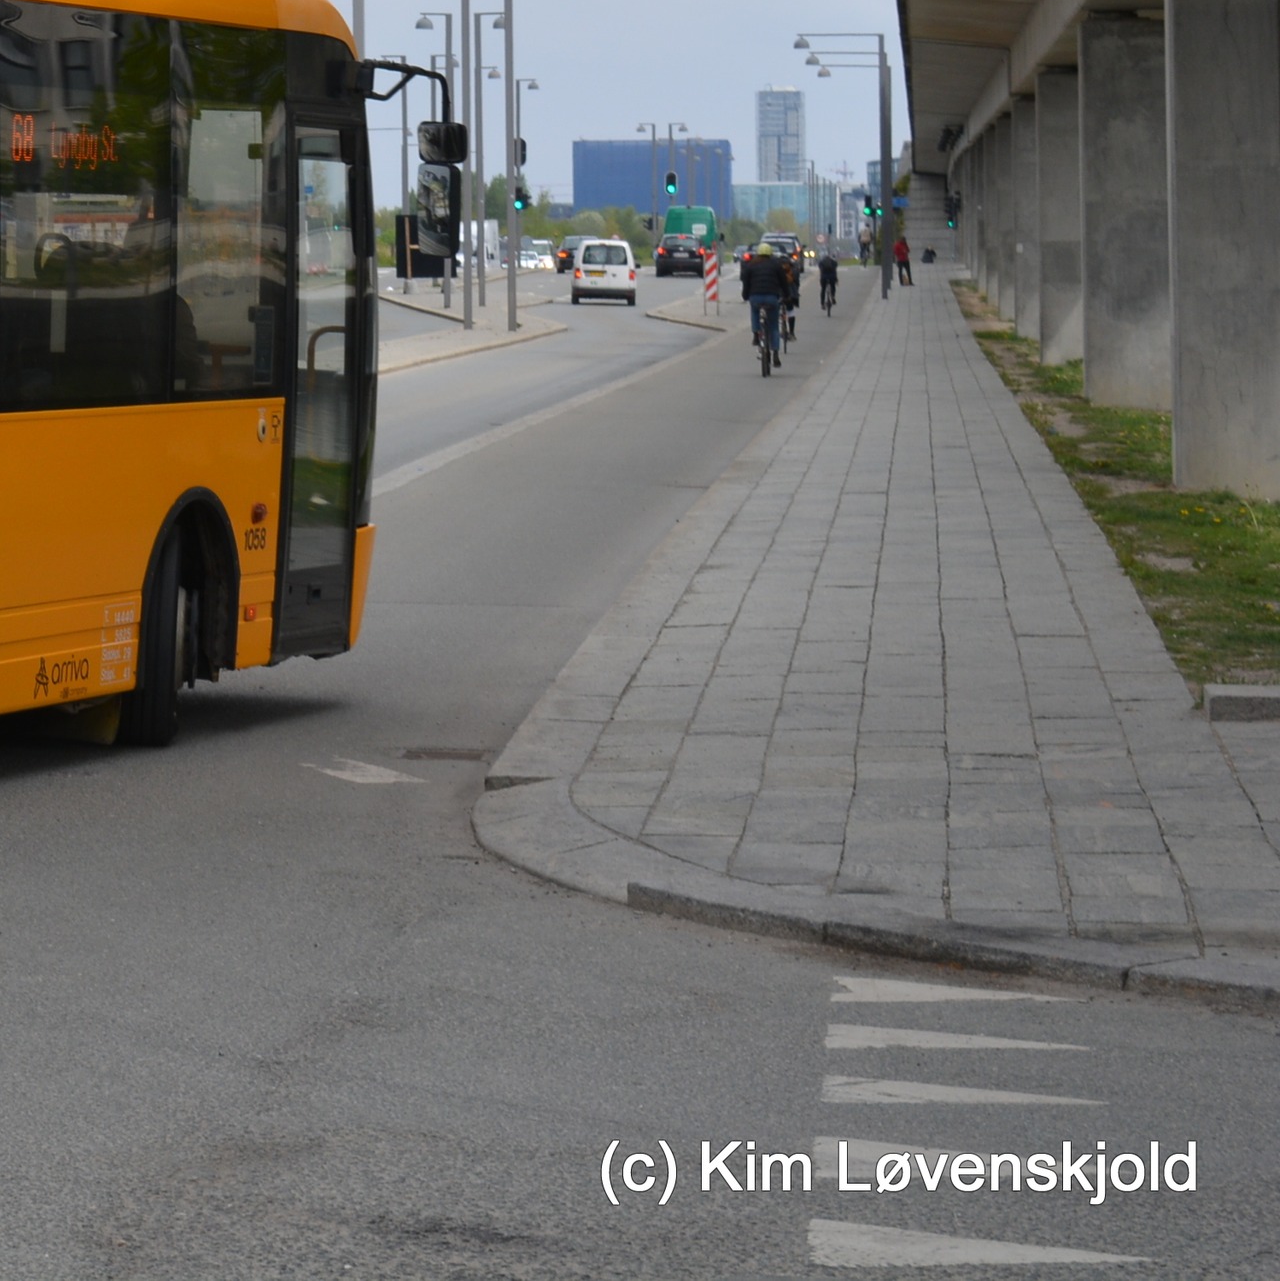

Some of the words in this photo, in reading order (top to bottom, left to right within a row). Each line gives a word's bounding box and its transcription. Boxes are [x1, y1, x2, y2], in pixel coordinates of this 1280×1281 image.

[12, 114, 34, 161] 68
[51, 121, 98, 170] Lyngby
[101, 125, 119, 161] St.
[244, 527, 267, 551] 1058
[51, 654, 89, 685] arriva
